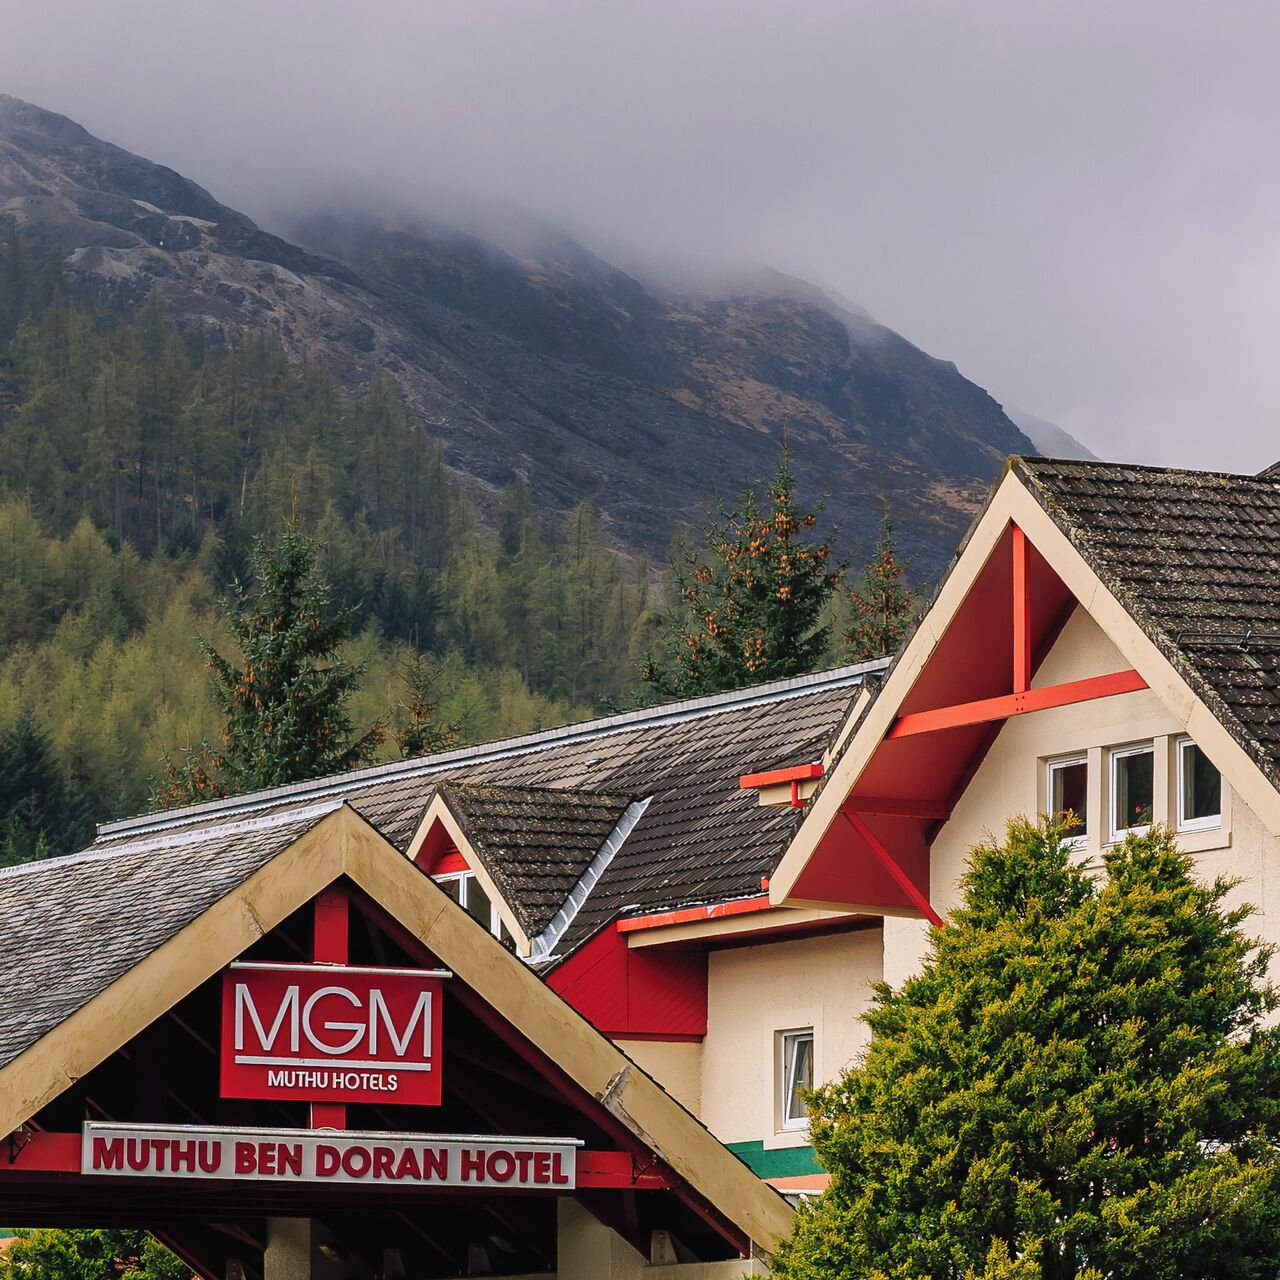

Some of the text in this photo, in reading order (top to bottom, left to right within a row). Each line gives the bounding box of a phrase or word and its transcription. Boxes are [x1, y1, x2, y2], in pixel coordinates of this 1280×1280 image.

[234, 983, 433, 1058] MGM
[267, 1070, 398, 1092] MUTHU HOTELS
[92, 1137, 569, 1184] MUTHU BEN DORAN HOTEL
